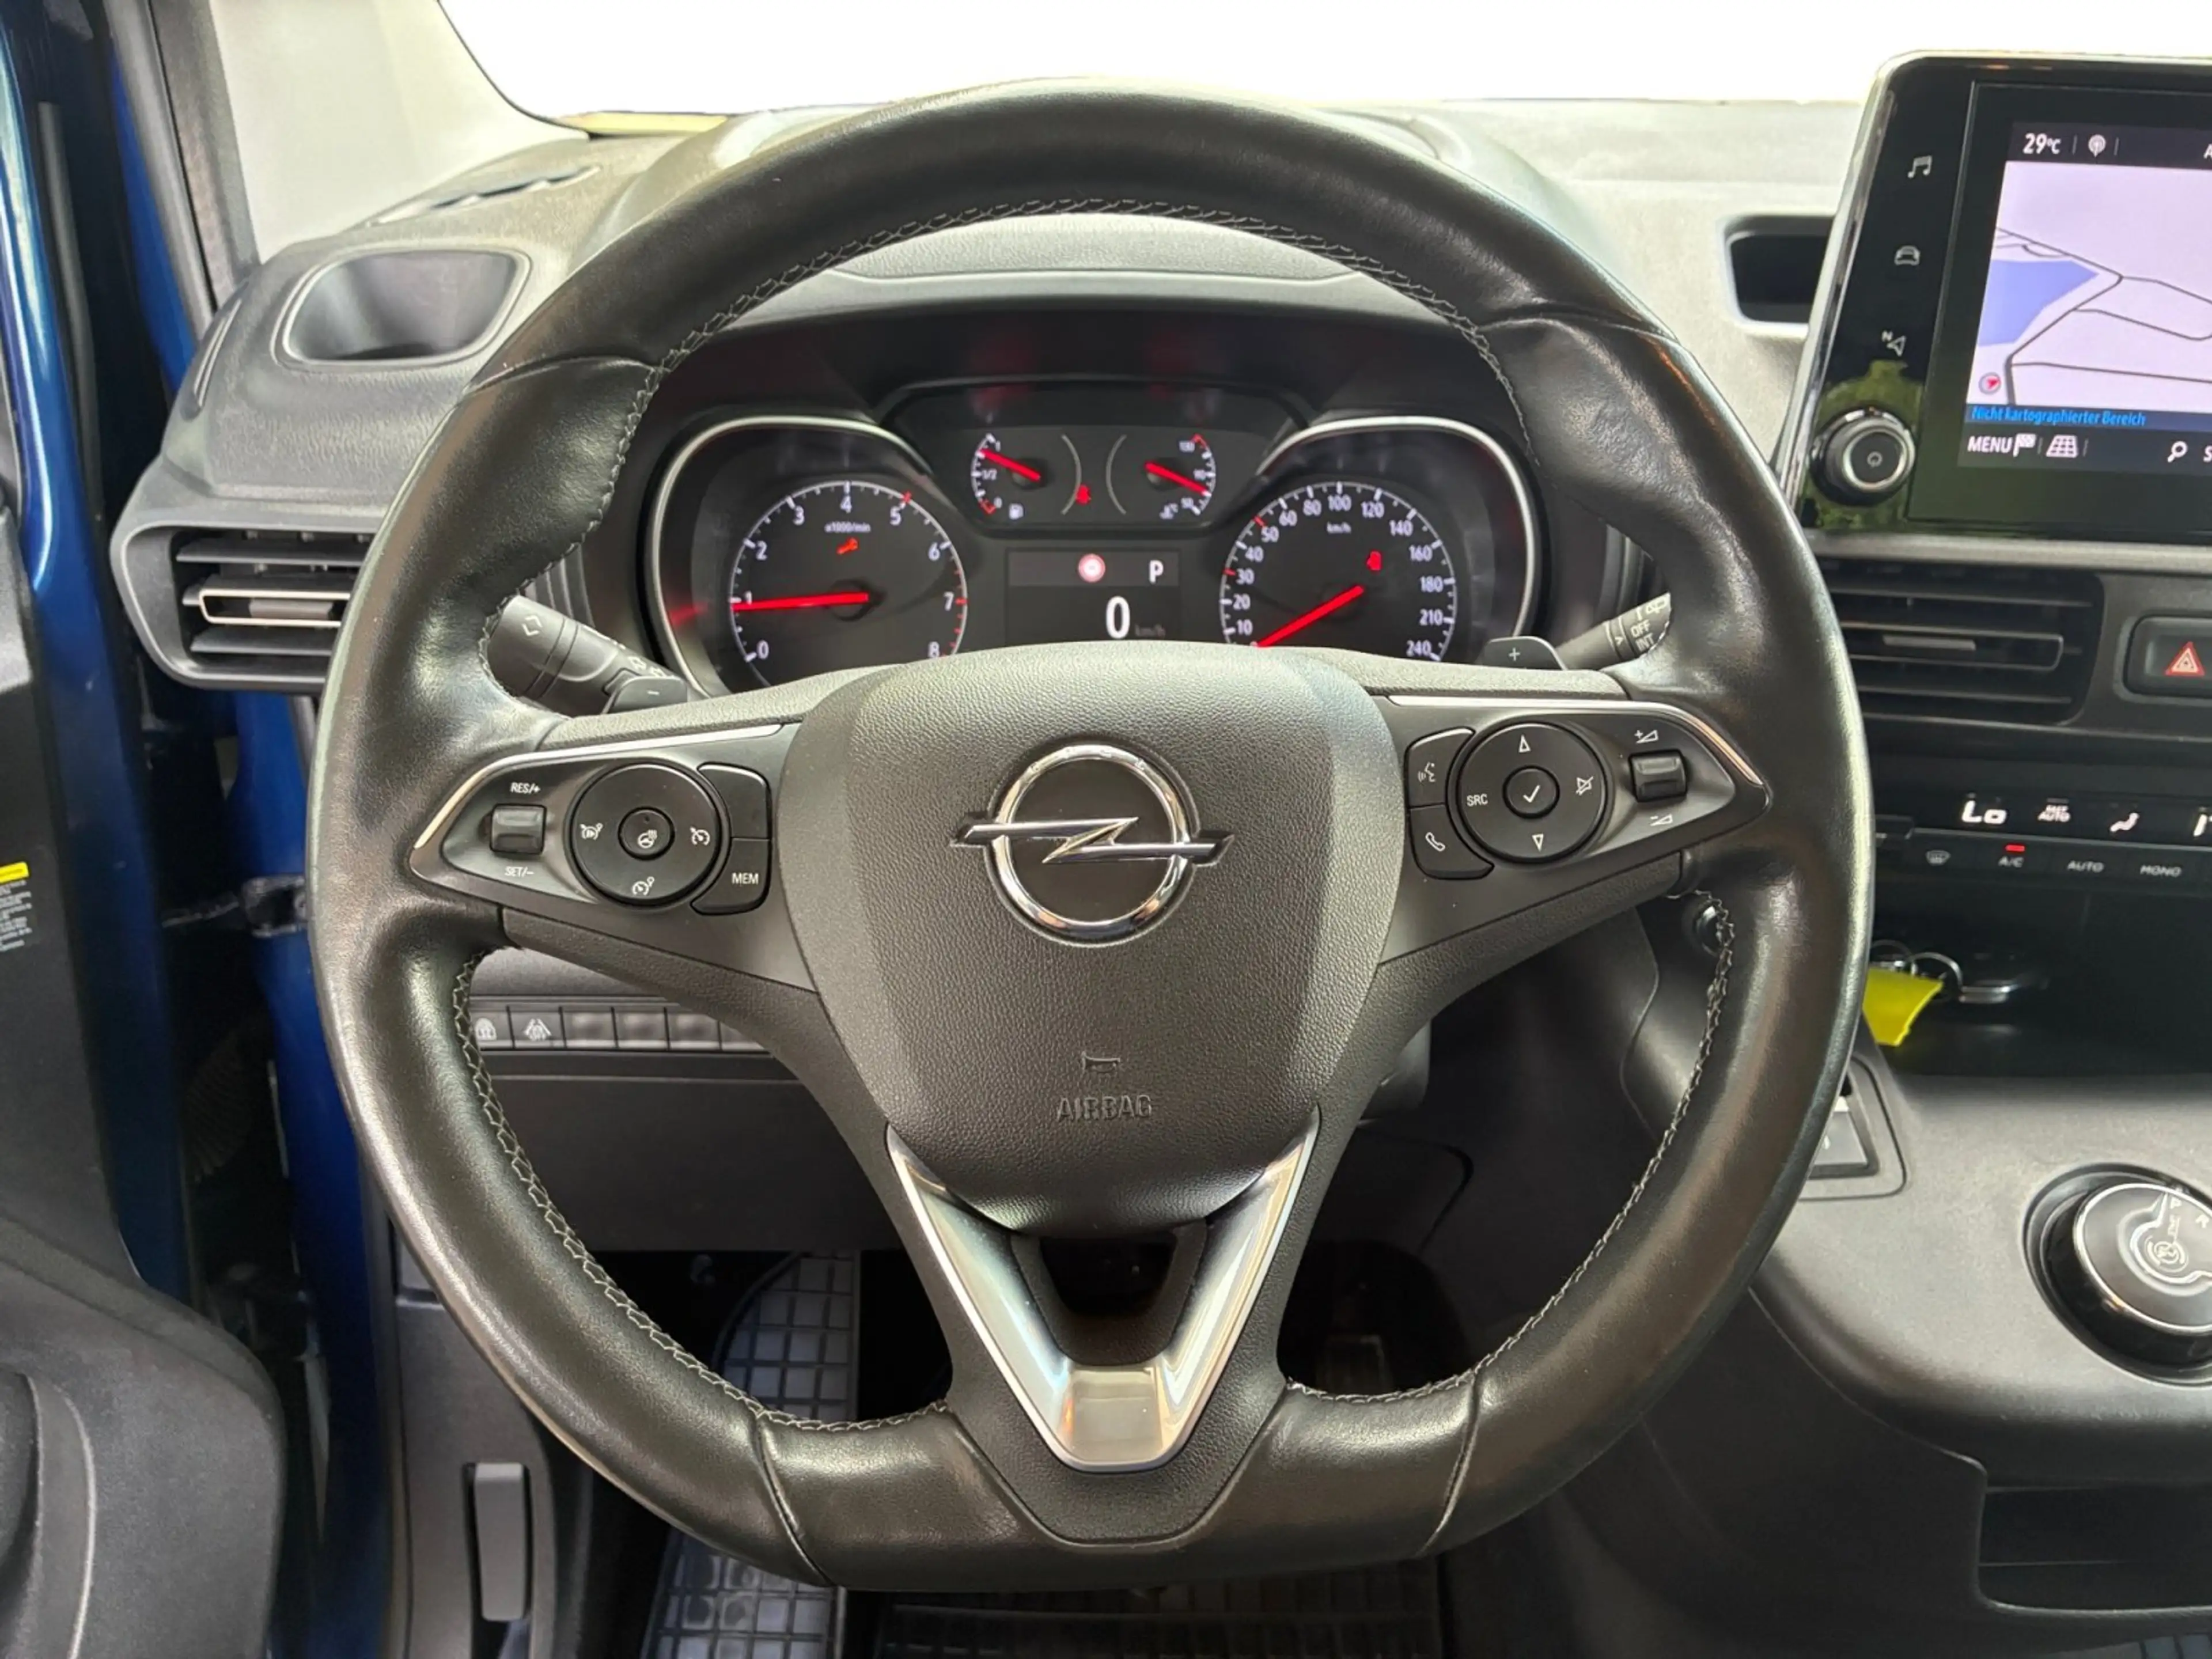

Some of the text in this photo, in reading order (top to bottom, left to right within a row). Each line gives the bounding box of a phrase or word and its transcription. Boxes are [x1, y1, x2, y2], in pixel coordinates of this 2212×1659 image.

[1972, 406, 2146, 426] Nicht kartographierter Bereich
[1968, 436, 2013, 453] MENU
[840, 496, 852, 513] 4
[1303, 499, 1322, 516] 80
[1328, 494, 1351, 511] 100
[1361, 501, 1384, 518] 120
[793, 505, 805, 525] 3
[889, 505, 902, 525] 5
[1279, 510, 1297, 527] 60
[1261, 526, 1279, 543] 50
[1389, 520, 1413, 536] 140
[756, 540, 768, 560] 2
[928, 542, 940, 561] 6
[1245, 546, 1264, 563] 40
[1409, 545, 1433, 562] 160
[1149, 556, 1164, 584] P
[1236, 567, 1255, 585] 30
[1420, 576, 1444, 593] 180
[943, 591, 954, 611] 7
[1233, 593, 1251, 610] 20
[1105, 595, 1130, 639] 0
[1419, 609, 1444, 626] 210
[1237, 619, 1253, 636] 10
[1630, 620, 1652, 638] OFF
[756, 639, 769, 660] 0
[928, 641, 940, 658] 8
[1407, 640, 1431, 657] 240
[1634, 634, 1656, 652] INT
[1466, 793, 1488, 807] SRC
[1998, 855, 2025, 868] A/C
[2067, 861, 2105, 873] AUTO
[731, 872, 759, 885] MEM
[2139, 865, 2183, 878] MONO
[1056, 1094, 1152, 1123] AIRBAG
